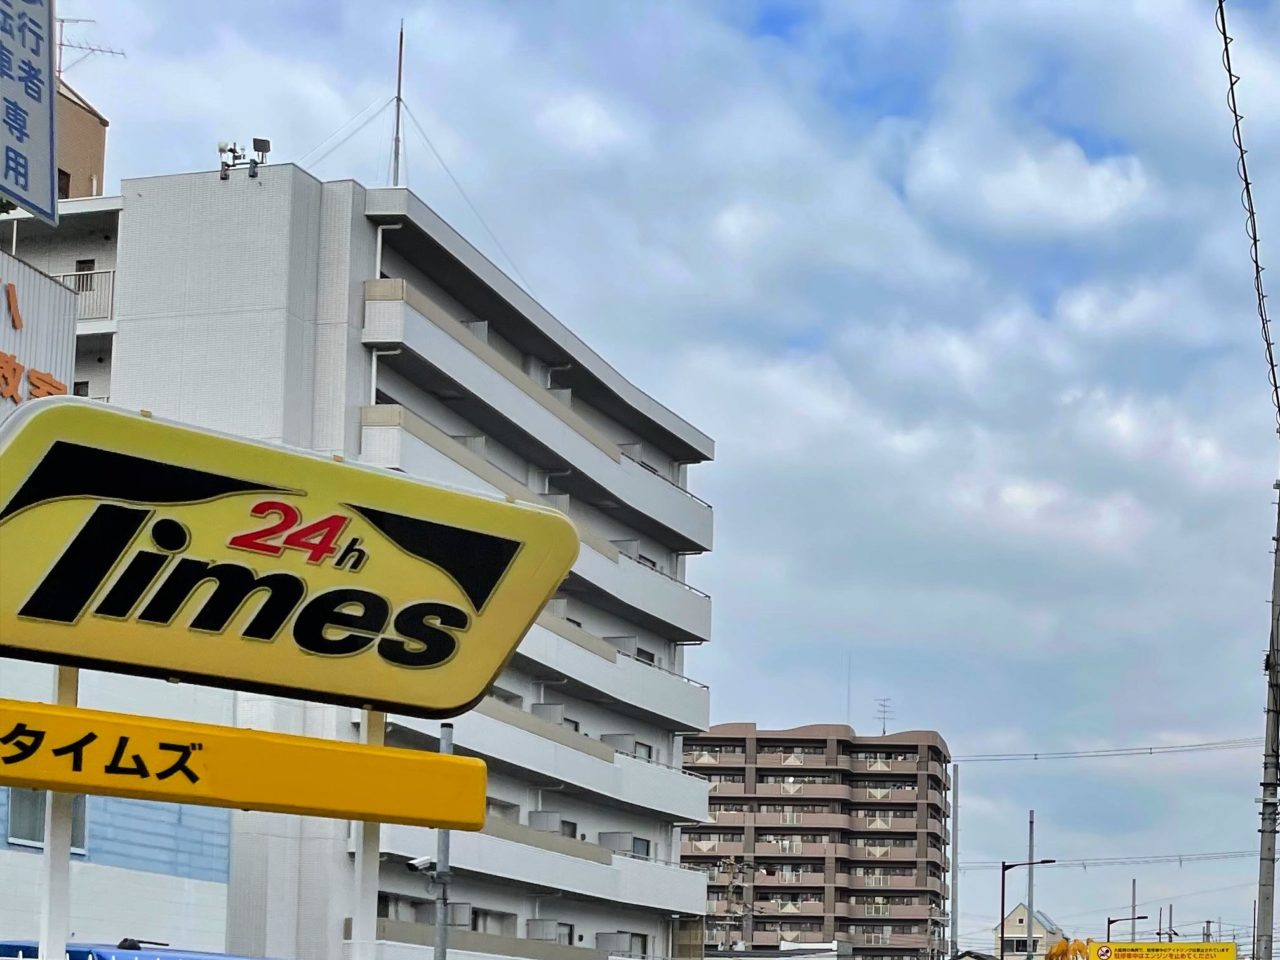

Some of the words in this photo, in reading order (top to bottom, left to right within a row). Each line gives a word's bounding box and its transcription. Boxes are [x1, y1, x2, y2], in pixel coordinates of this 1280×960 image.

[3, 97, 31, 192] 専用
[228, 500, 369, 573] 24h
[10, 490, 474, 670] Times
[0, 722, 204, 784] タイムズ
